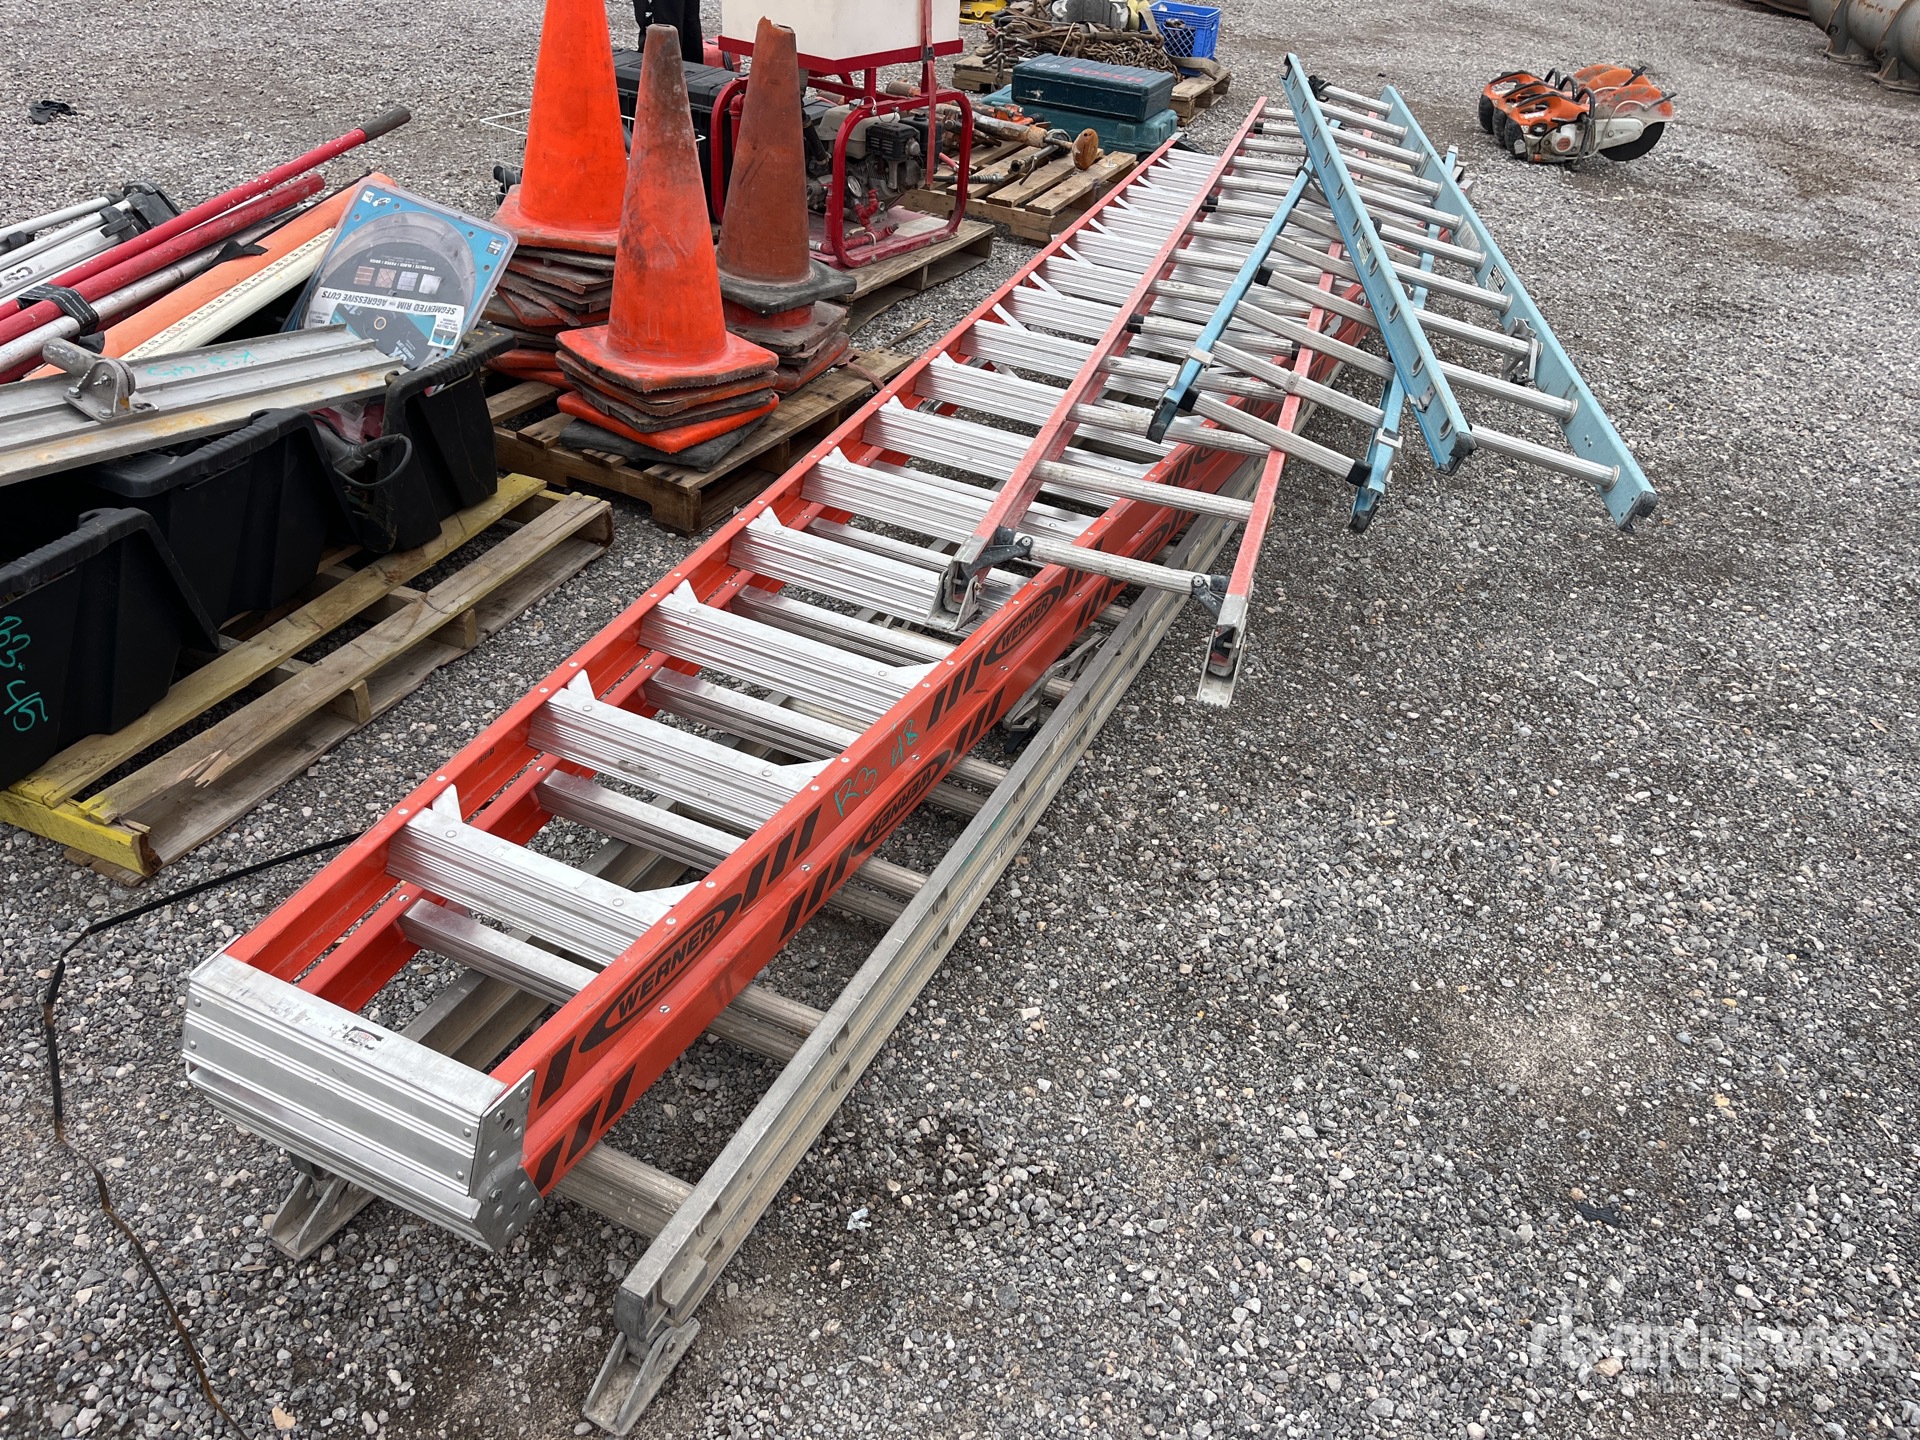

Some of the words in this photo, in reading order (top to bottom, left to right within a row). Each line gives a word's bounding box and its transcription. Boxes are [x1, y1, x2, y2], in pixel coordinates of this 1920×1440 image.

[1071, 67, 1144, 83] BOSCH
[321, 290, 342, 300] CUTS
[341, 292, 388, 307] AGGRESSIVE
[396, 300, 413, 310] RIM
[413, 302, 457, 315] SEGMENTED
[1002, 596, 1050, 651] WERNER
[870, 767, 932, 840] WERNER
[620, 915, 717, 1020] WERNER
